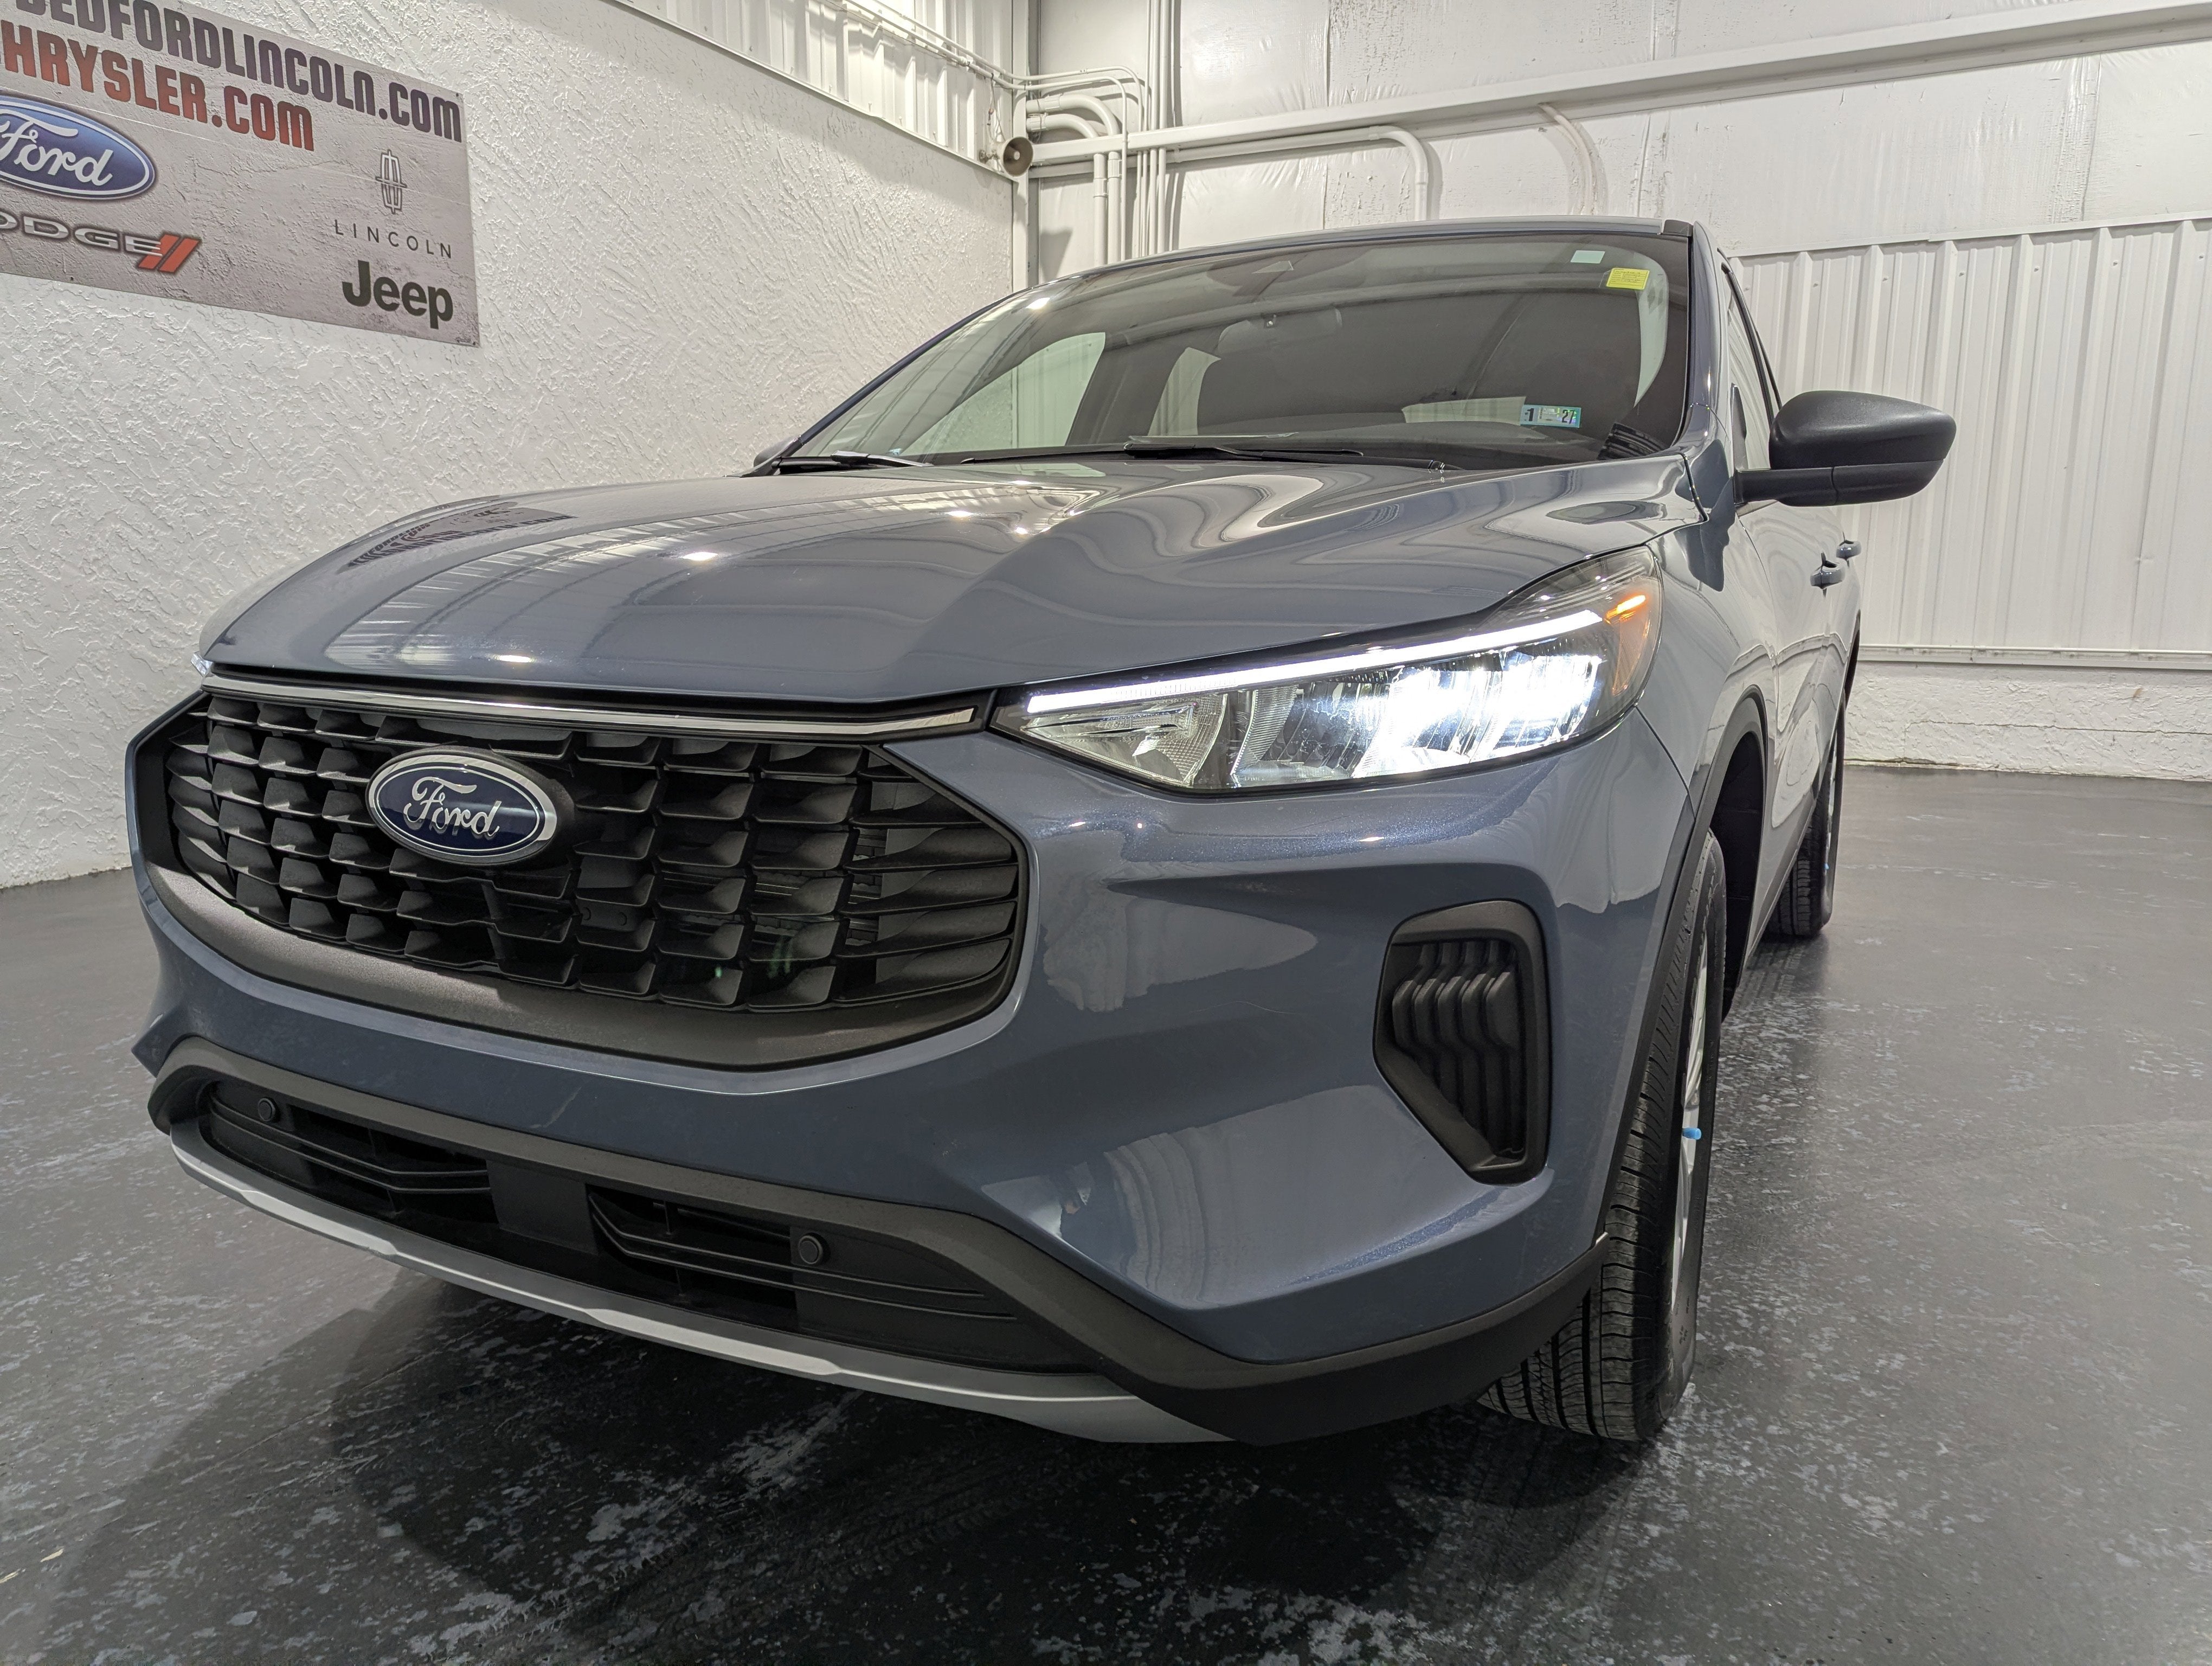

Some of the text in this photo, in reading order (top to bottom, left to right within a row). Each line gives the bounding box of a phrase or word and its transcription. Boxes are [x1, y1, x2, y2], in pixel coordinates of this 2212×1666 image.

[15, 0, 462, 143] DFORDLINCOLN.COM
[0, 109, 113, 186] Ford
[335, 219, 452, 259] LINCOLN
[342, 259, 453, 330] Jeep
[403, 776, 500, 837] Ford
